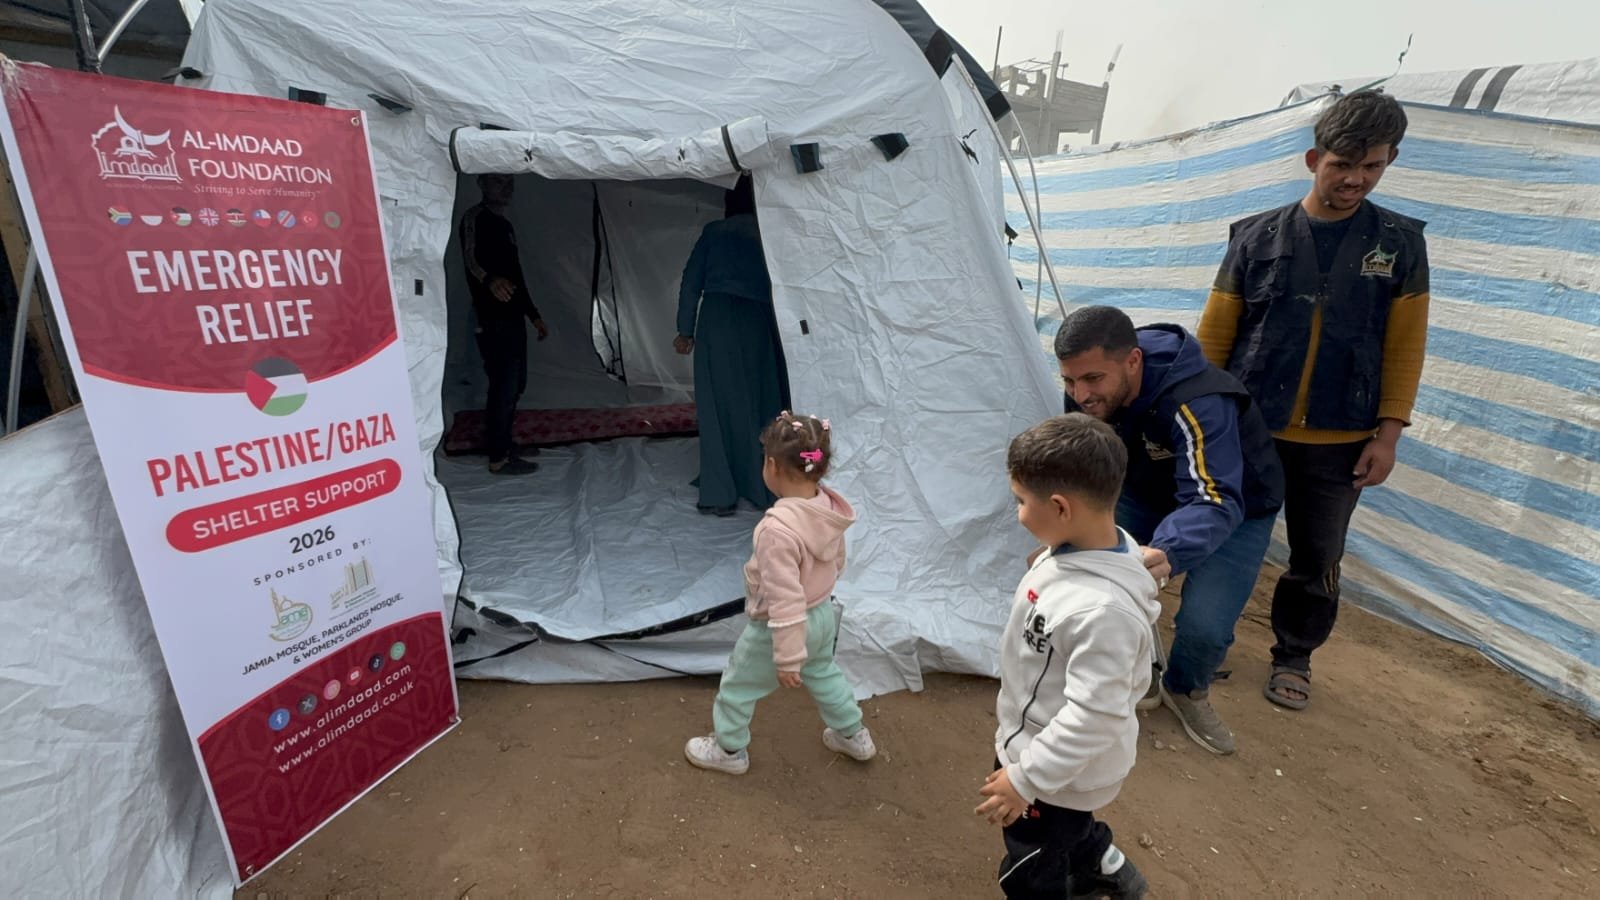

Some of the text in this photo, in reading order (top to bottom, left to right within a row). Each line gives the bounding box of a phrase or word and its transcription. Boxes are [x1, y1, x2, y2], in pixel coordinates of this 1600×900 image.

[182, 130, 303, 157] AL-IMDAAD
[188, 158, 333, 184] FOUNDATION
[194, 184, 234, 197] Striving
[236, 187, 246, 195] to
[247, 186, 272, 196] Serve
[126, 248, 342, 293] EMERGENCY
[196, 299, 313, 345] RELIEF
[147, 413, 396, 497] PALESTINE/GAZA
[192, 470, 387, 539] SHELTER SUPPORT
[289, 525, 336, 554] 2026
[253, 548, 343, 586] SPONSORED
[242, 655, 275, 675] JAMIA
[276, 634, 321, 660] MOSQUE,
[322, 609, 369, 638] PARKLANDS
[293, 618, 372, 665] & WOMEN'S GROUP
[273, 664, 412, 754] www.alimdaad.com
[279, 681, 414, 773] www.alimdaad.co.uk
